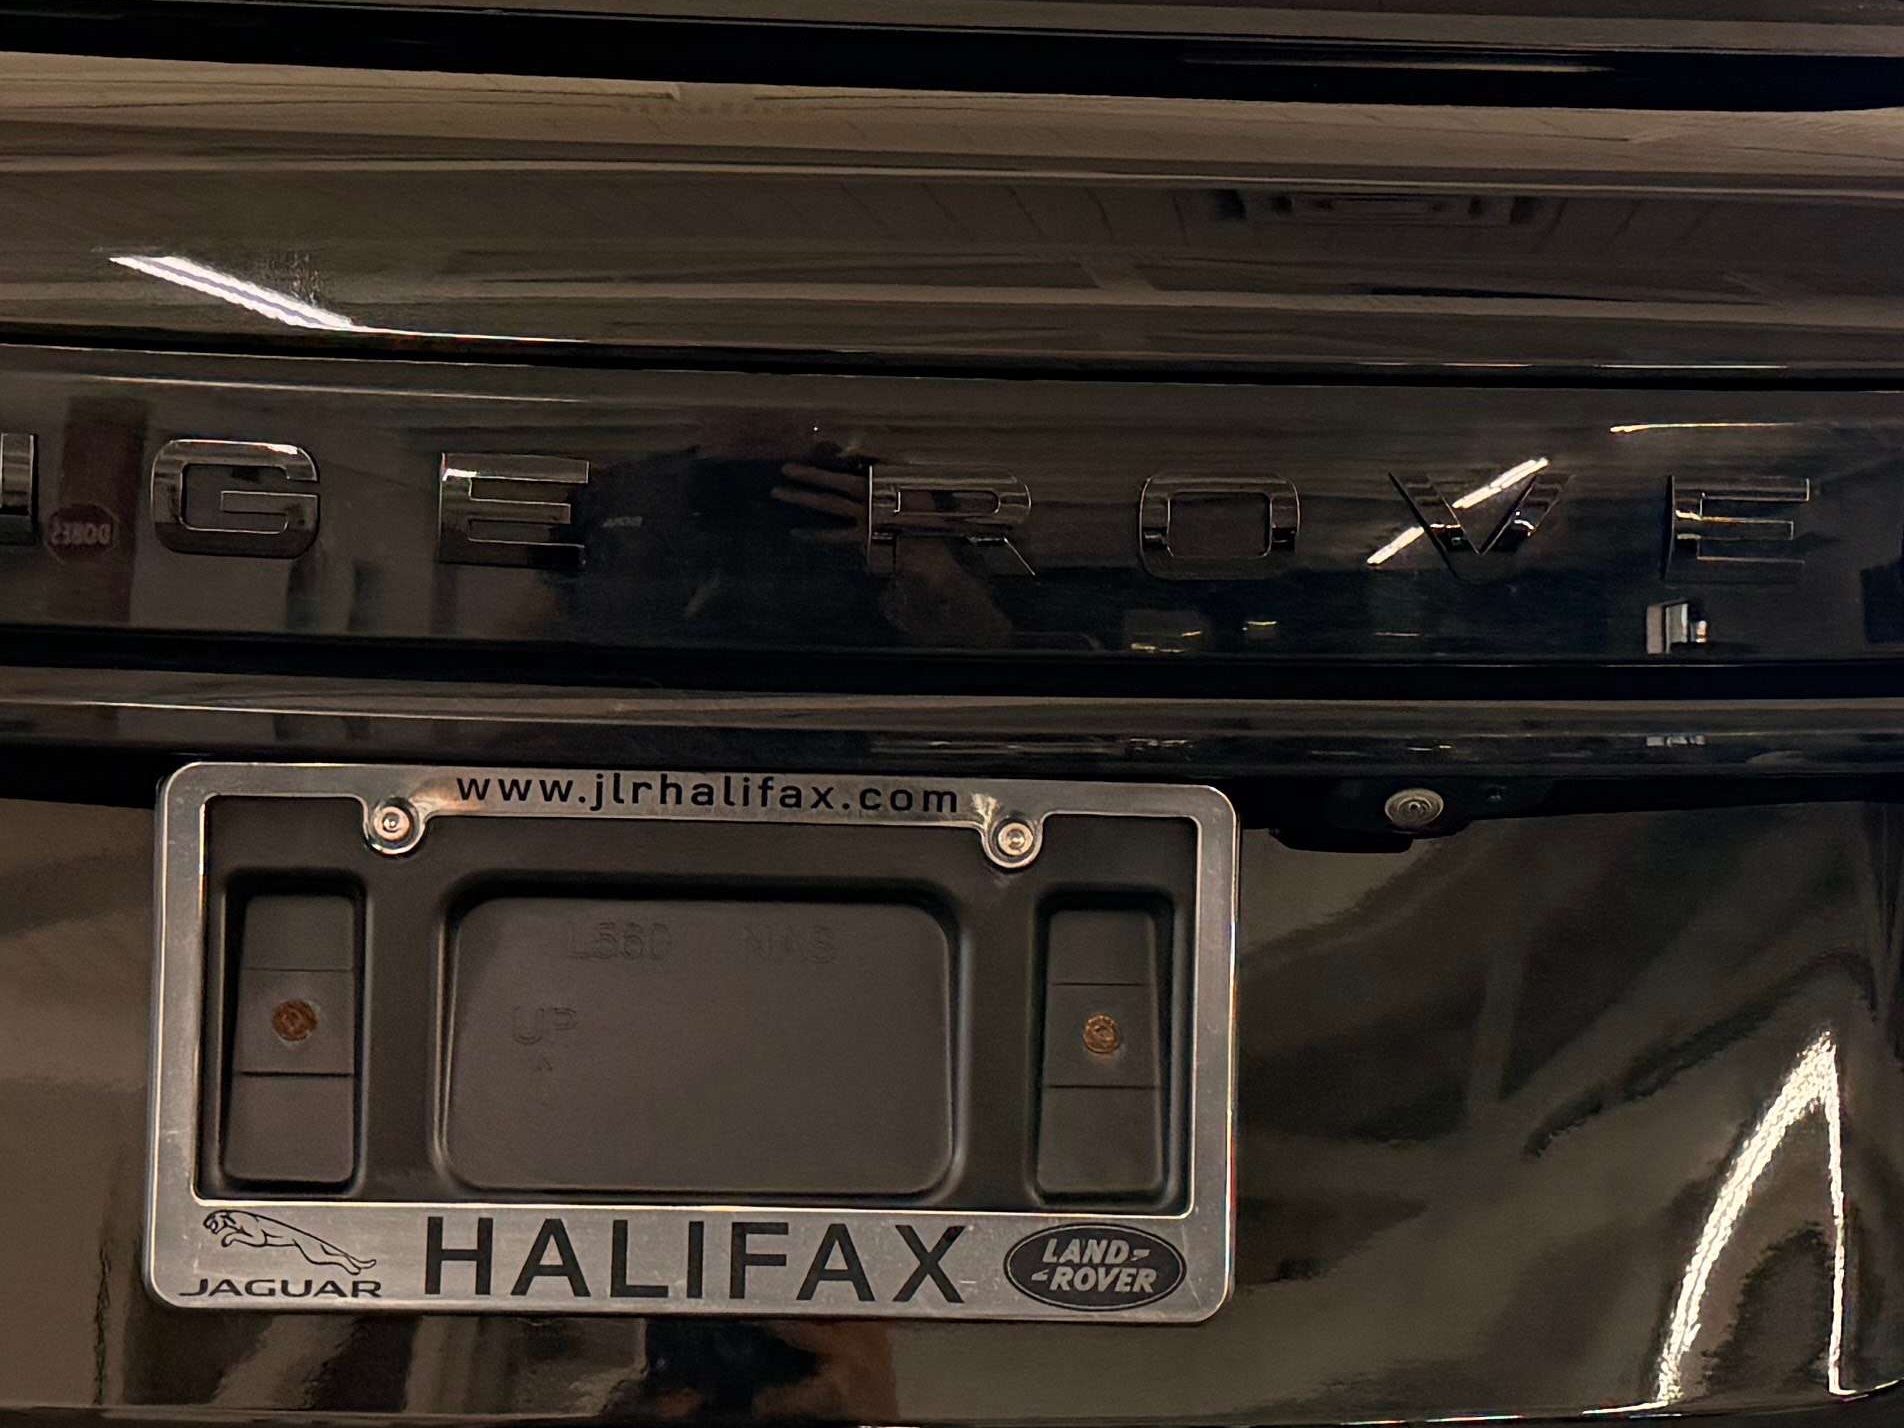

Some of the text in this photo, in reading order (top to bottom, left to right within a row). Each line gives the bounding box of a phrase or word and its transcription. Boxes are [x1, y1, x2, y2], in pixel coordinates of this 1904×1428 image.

[455, 772, 958, 814] www.jlrhalifax.com
[511, 1005, 580, 1047] UP
[424, 1215, 967, 1305] HALIFAX
[1041, 1237, 1130, 1266] LAND
[178, 1278, 383, 1300] JAGUAR
[1048, 1266, 1157, 1295] ROVER
